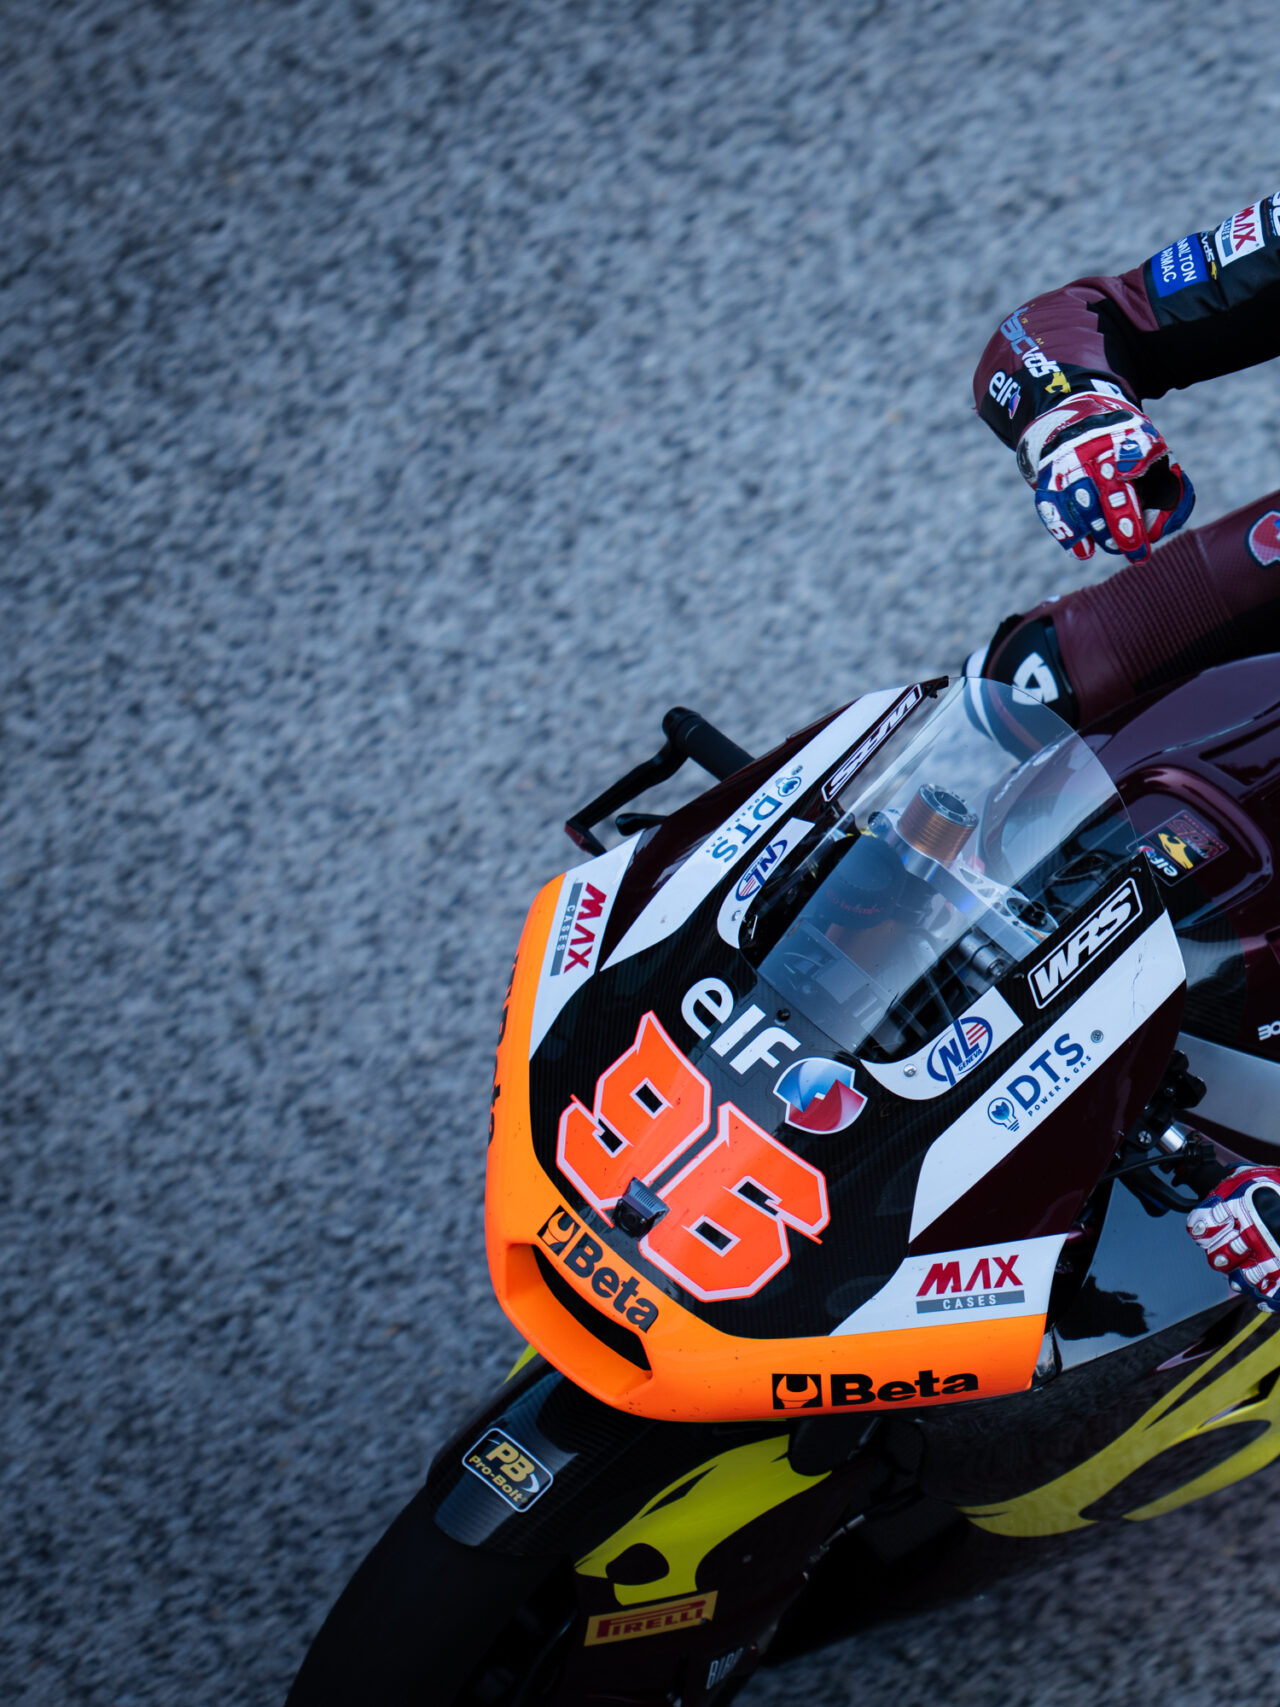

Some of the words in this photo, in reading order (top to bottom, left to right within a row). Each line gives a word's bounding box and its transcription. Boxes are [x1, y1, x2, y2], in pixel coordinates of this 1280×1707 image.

[989, 370, 1021, 406] elf
[712, 795, 783, 863] DTS
[556, 904, 576, 951] CASES
[564, 882, 607, 973] MAX
[1033, 886, 1132, 1000] WRS
[681, 977, 802, 1075] elf
[958, 1048, 983, 1072] GENEVA
[1006, 1033, 1084, 1111] DTS
[1027, 1085, 1061, 1117] POWER
[1073, 1055, 1092, 1074] GAS
[556, 1010, 831, 1303] 96
[563, 1231, 660, 1333] Beta
[916, 1254, 1024, 1297] MAX
[943, 1294, 997, 1310] CASES
[830, 1370, 979, 1407] Beta
[468, 1455, 523, 1502] Pro-Bolt
[485, 1441, 535, 1482] PB
[596, 1599, 707, 1639] PIRELLI
